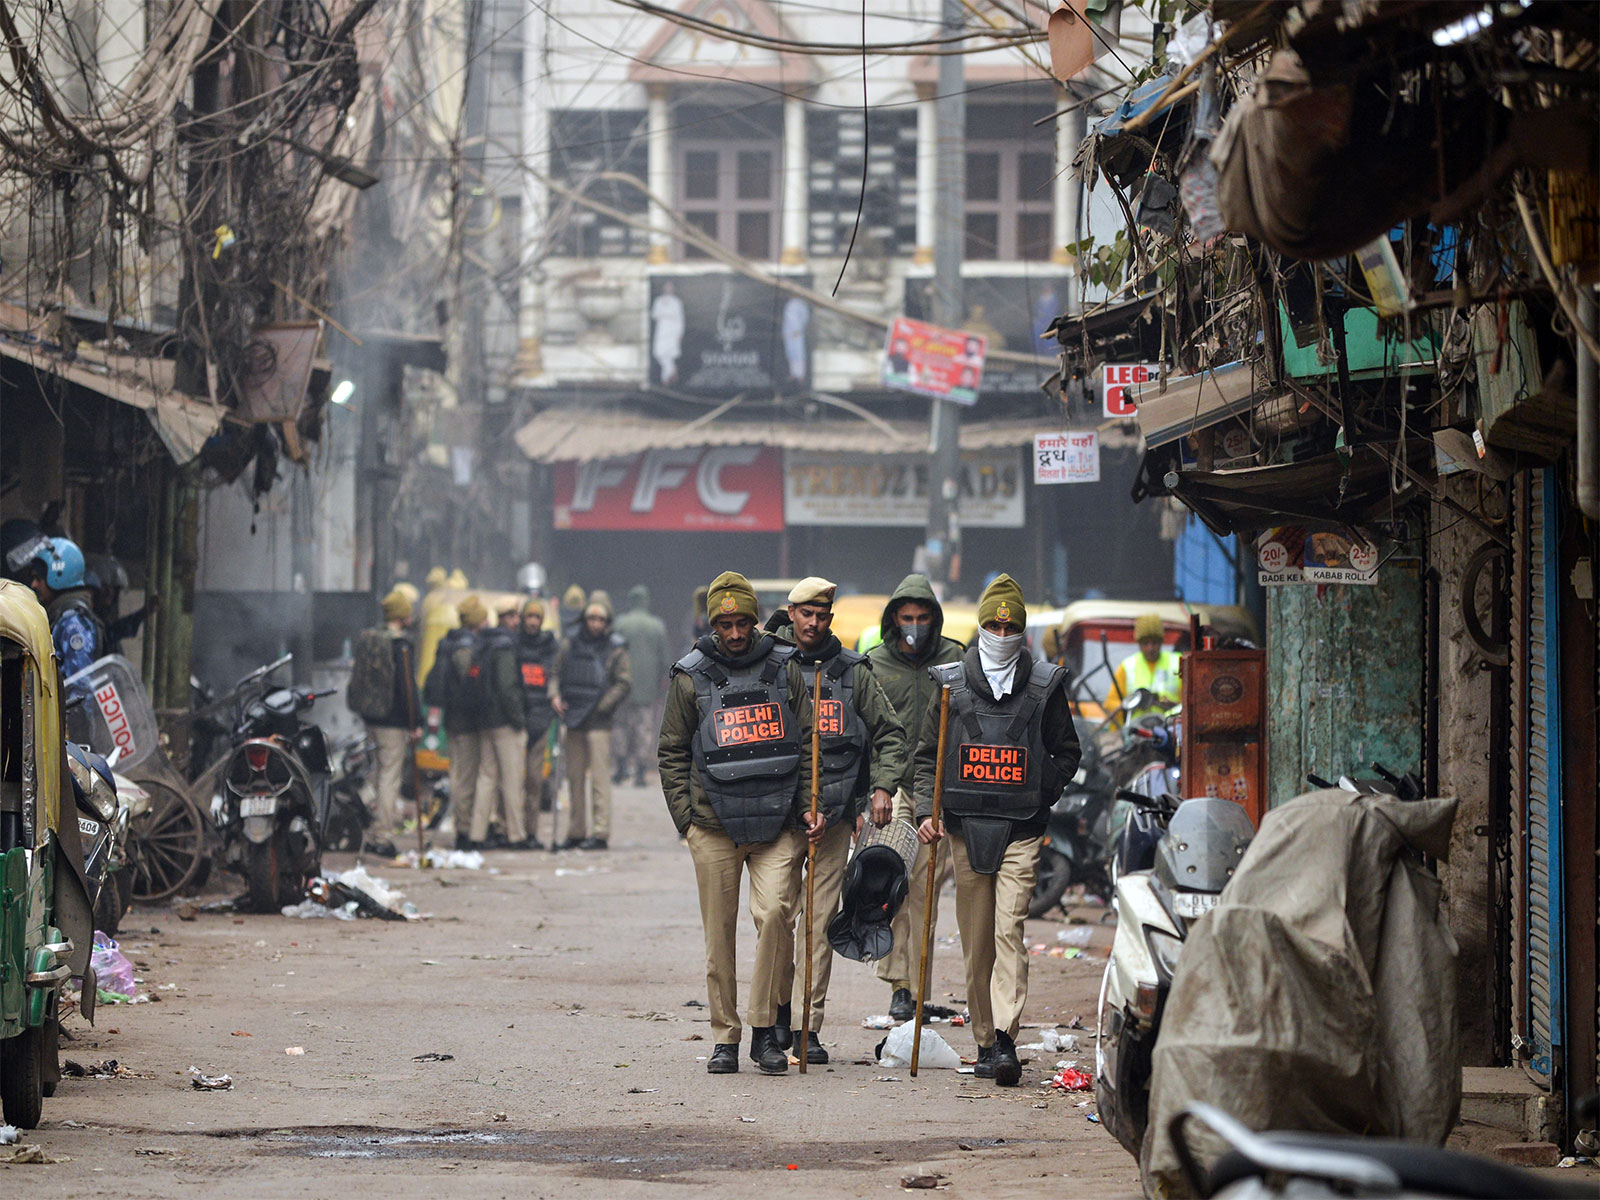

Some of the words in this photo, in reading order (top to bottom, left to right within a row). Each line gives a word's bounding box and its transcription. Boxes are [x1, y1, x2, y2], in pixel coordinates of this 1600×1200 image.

[1106, 366, 1148, 384] LEG
[1038, 436, 1067, 449] हमारे
[569, 447, 760, 515] FFC
[1263, 547, 1285, 561] 20/-
[52, 561, 66, 571] RAF
[1261, 574, 1285, 582] BADE
[1287, 574, 1299, 582] KE
[1313, 571, 1343, 580] KABAB
[1345, 572, 1367, 581] ROLL
[97, 685, 135, 760] POLICE
[724, 706, 772, 726] DELHI
[721, 721, 780, 743] POLICE
[968, 748, 1018, 764] DELHI
[963, 764, 1023, 781] POLICE
